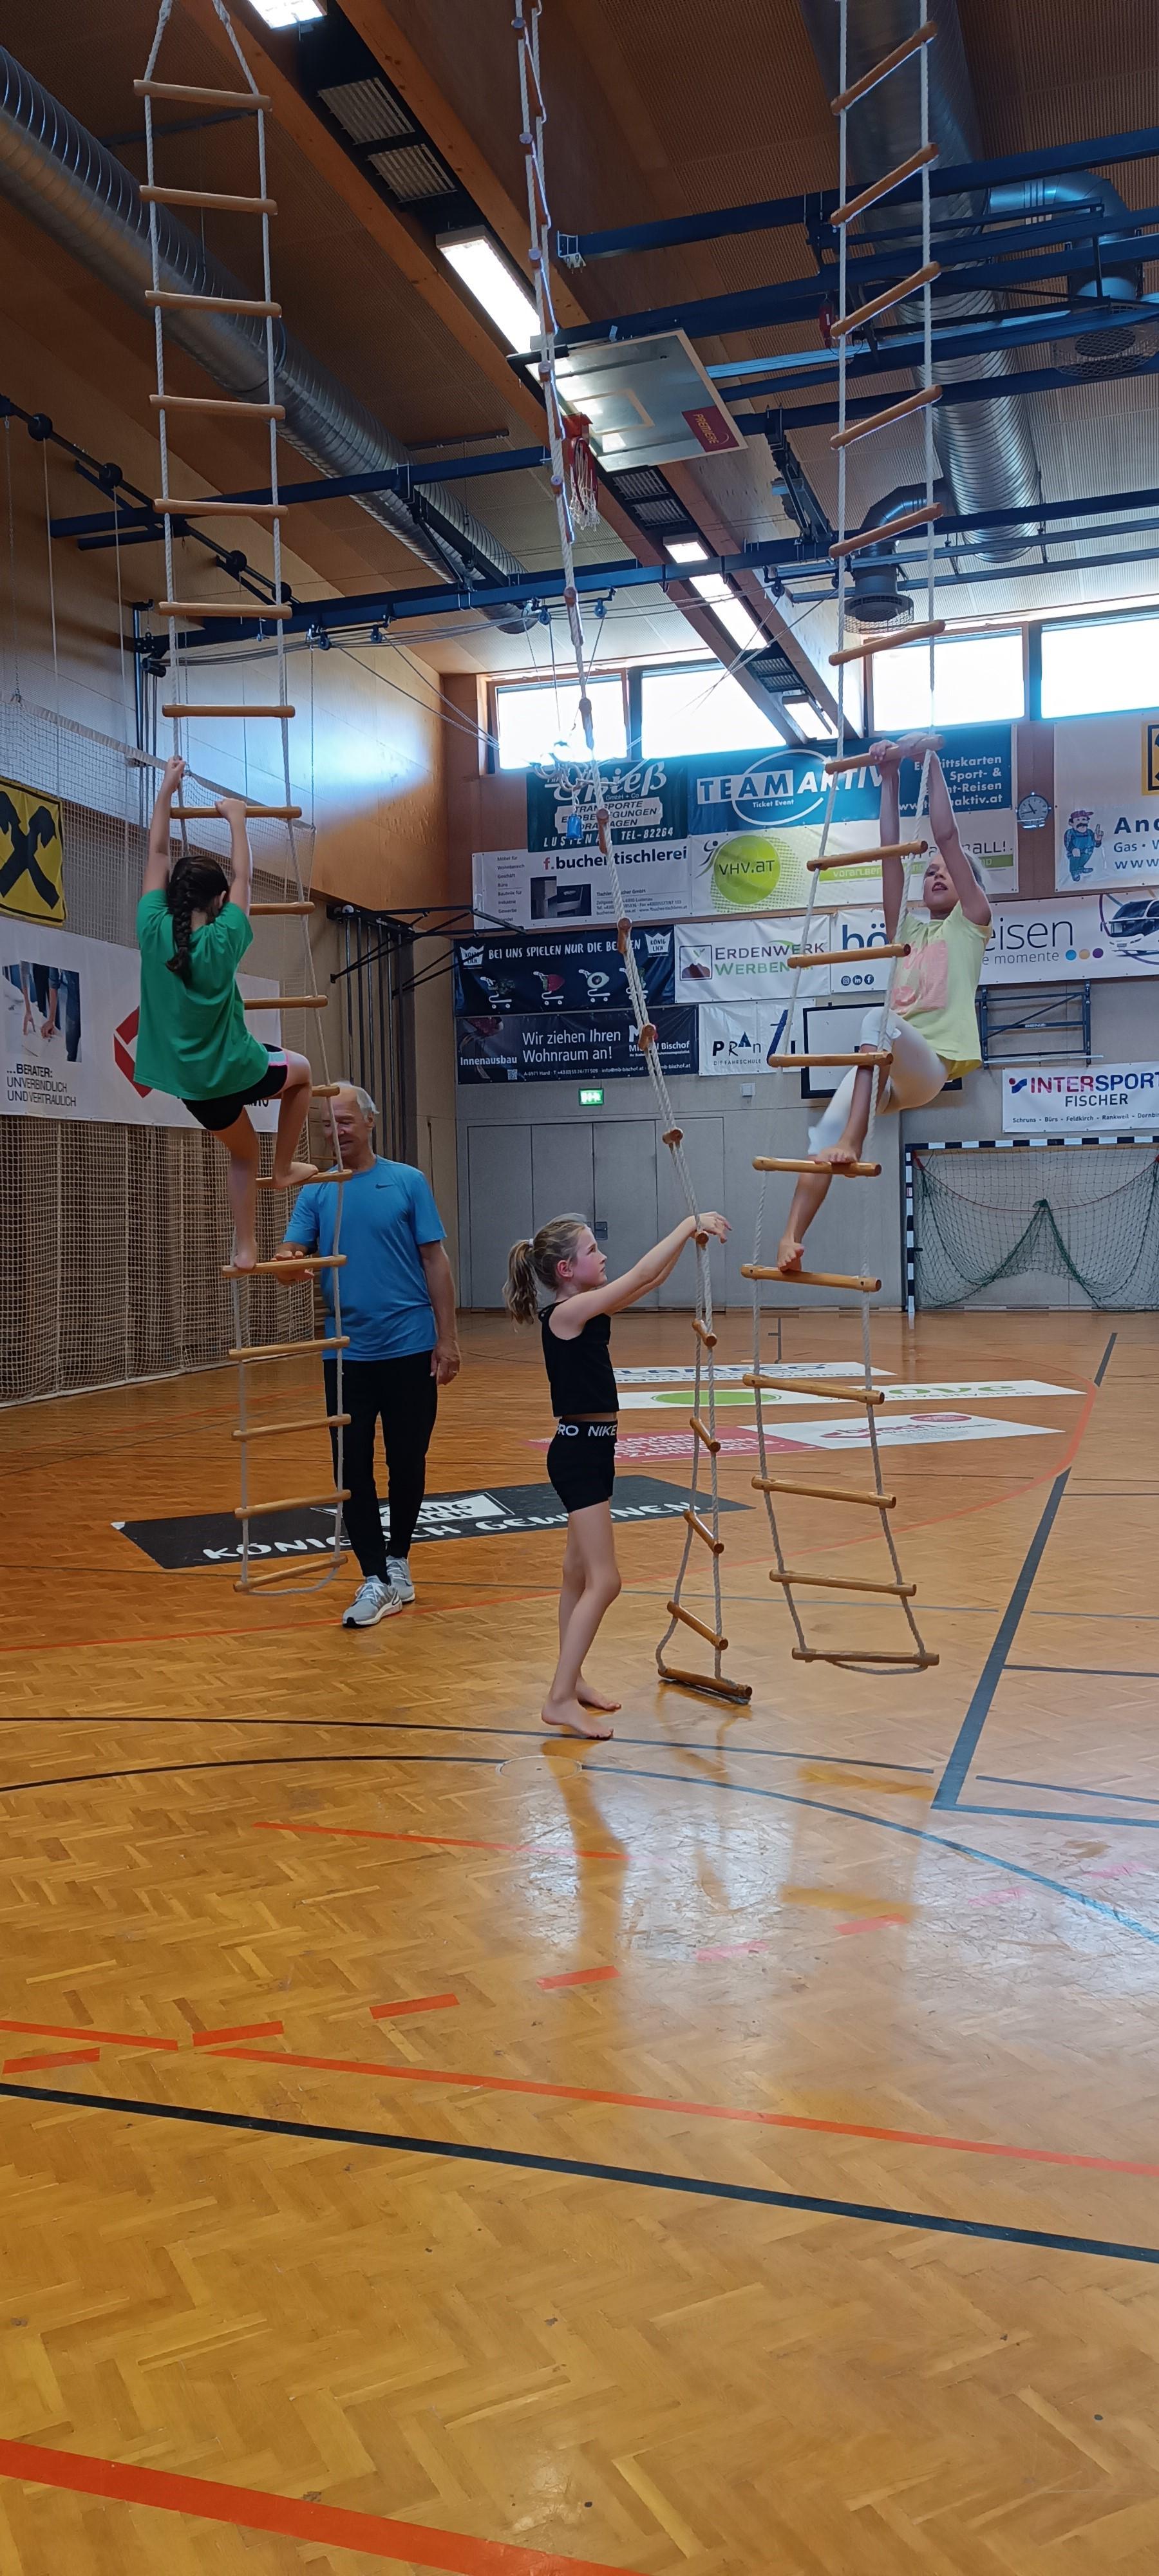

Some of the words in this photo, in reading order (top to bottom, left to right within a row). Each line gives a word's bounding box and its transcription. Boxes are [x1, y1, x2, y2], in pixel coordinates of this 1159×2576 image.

[692, 413, 719, 444] PREMIERE
[950, 770, 988, 782] Sport-
[992, 768, 1002, 777] &
[699, 772, 789, 801] TEAM
[752, 799, 773, 808] Ticket
[1113, 842, 1137, 853] Gas
[489, 948, 502, 960] BEI
[505, 947, 523, 958] UNS
[526, 944, 561, 958] SPIELEN
[564, 943, 584, 955] NUR
[587, 942, 603, 953] DIE
[606, 938, 641, 952] BEEN
[994, 951, 1059, 965] momente
[523, 1032, 543, 1045] Wir
[547, 1030, 585, 1045] ziehen
[590, 1028, 621, 1042] Ihren
[661, 1040, 690, 1050] Bischof
[460, 1056, 518, 1066] Innenausbau
[522, 1048, 589, 1063] Wohnraum
[592, 1046, 612, 1060] an!
[1065, 1093, 1128, 1107] FISCHER
[889, 1386, 1017, 1395] ove
[588, 1424, 617, 1437] NIKE
